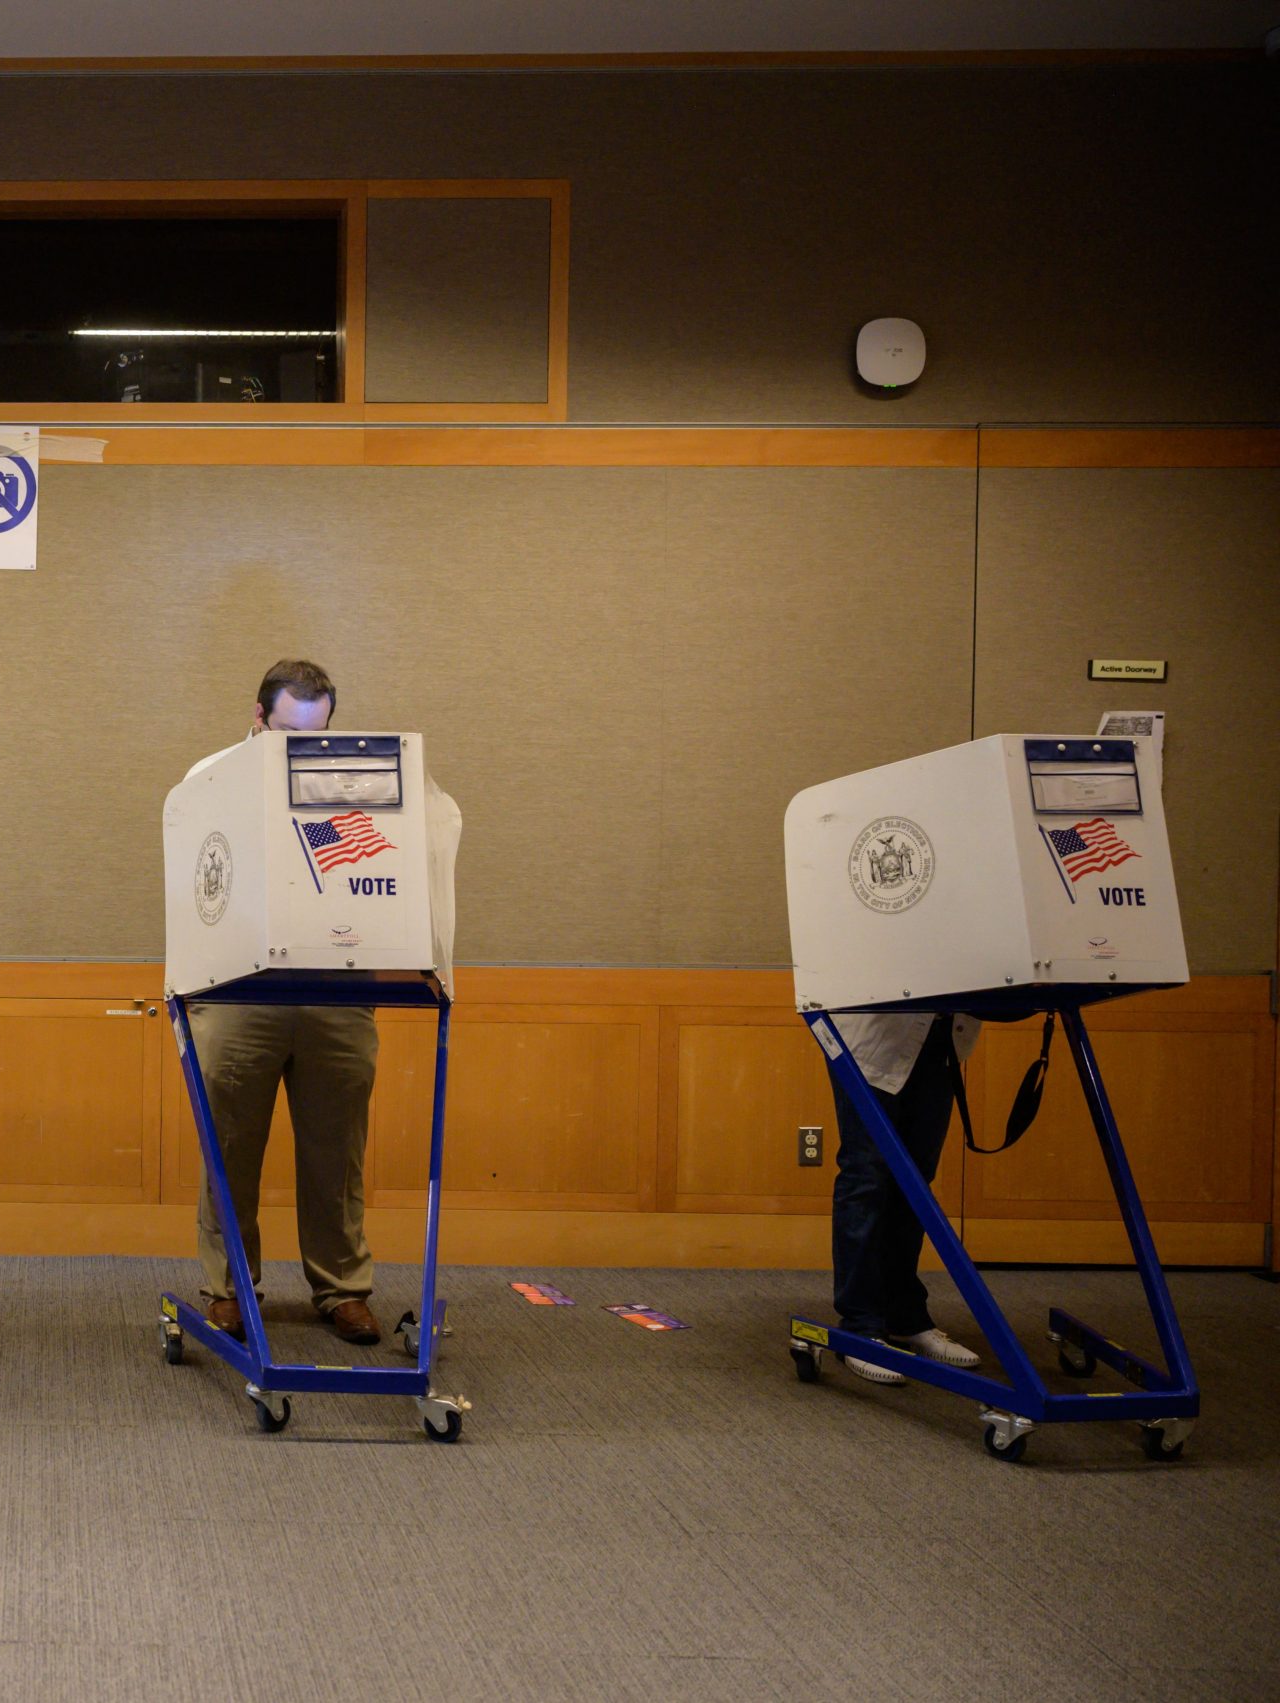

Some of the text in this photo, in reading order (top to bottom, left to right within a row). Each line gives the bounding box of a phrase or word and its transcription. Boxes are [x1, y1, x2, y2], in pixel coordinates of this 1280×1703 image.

[1100, 665, 1157, 674] Active Doorway
[853, 820, 926, 862] BOARD OF ELECTIONS
[348, 877, 396, 896] VOTE
[1098, 887, 1147, 907] VOTE
